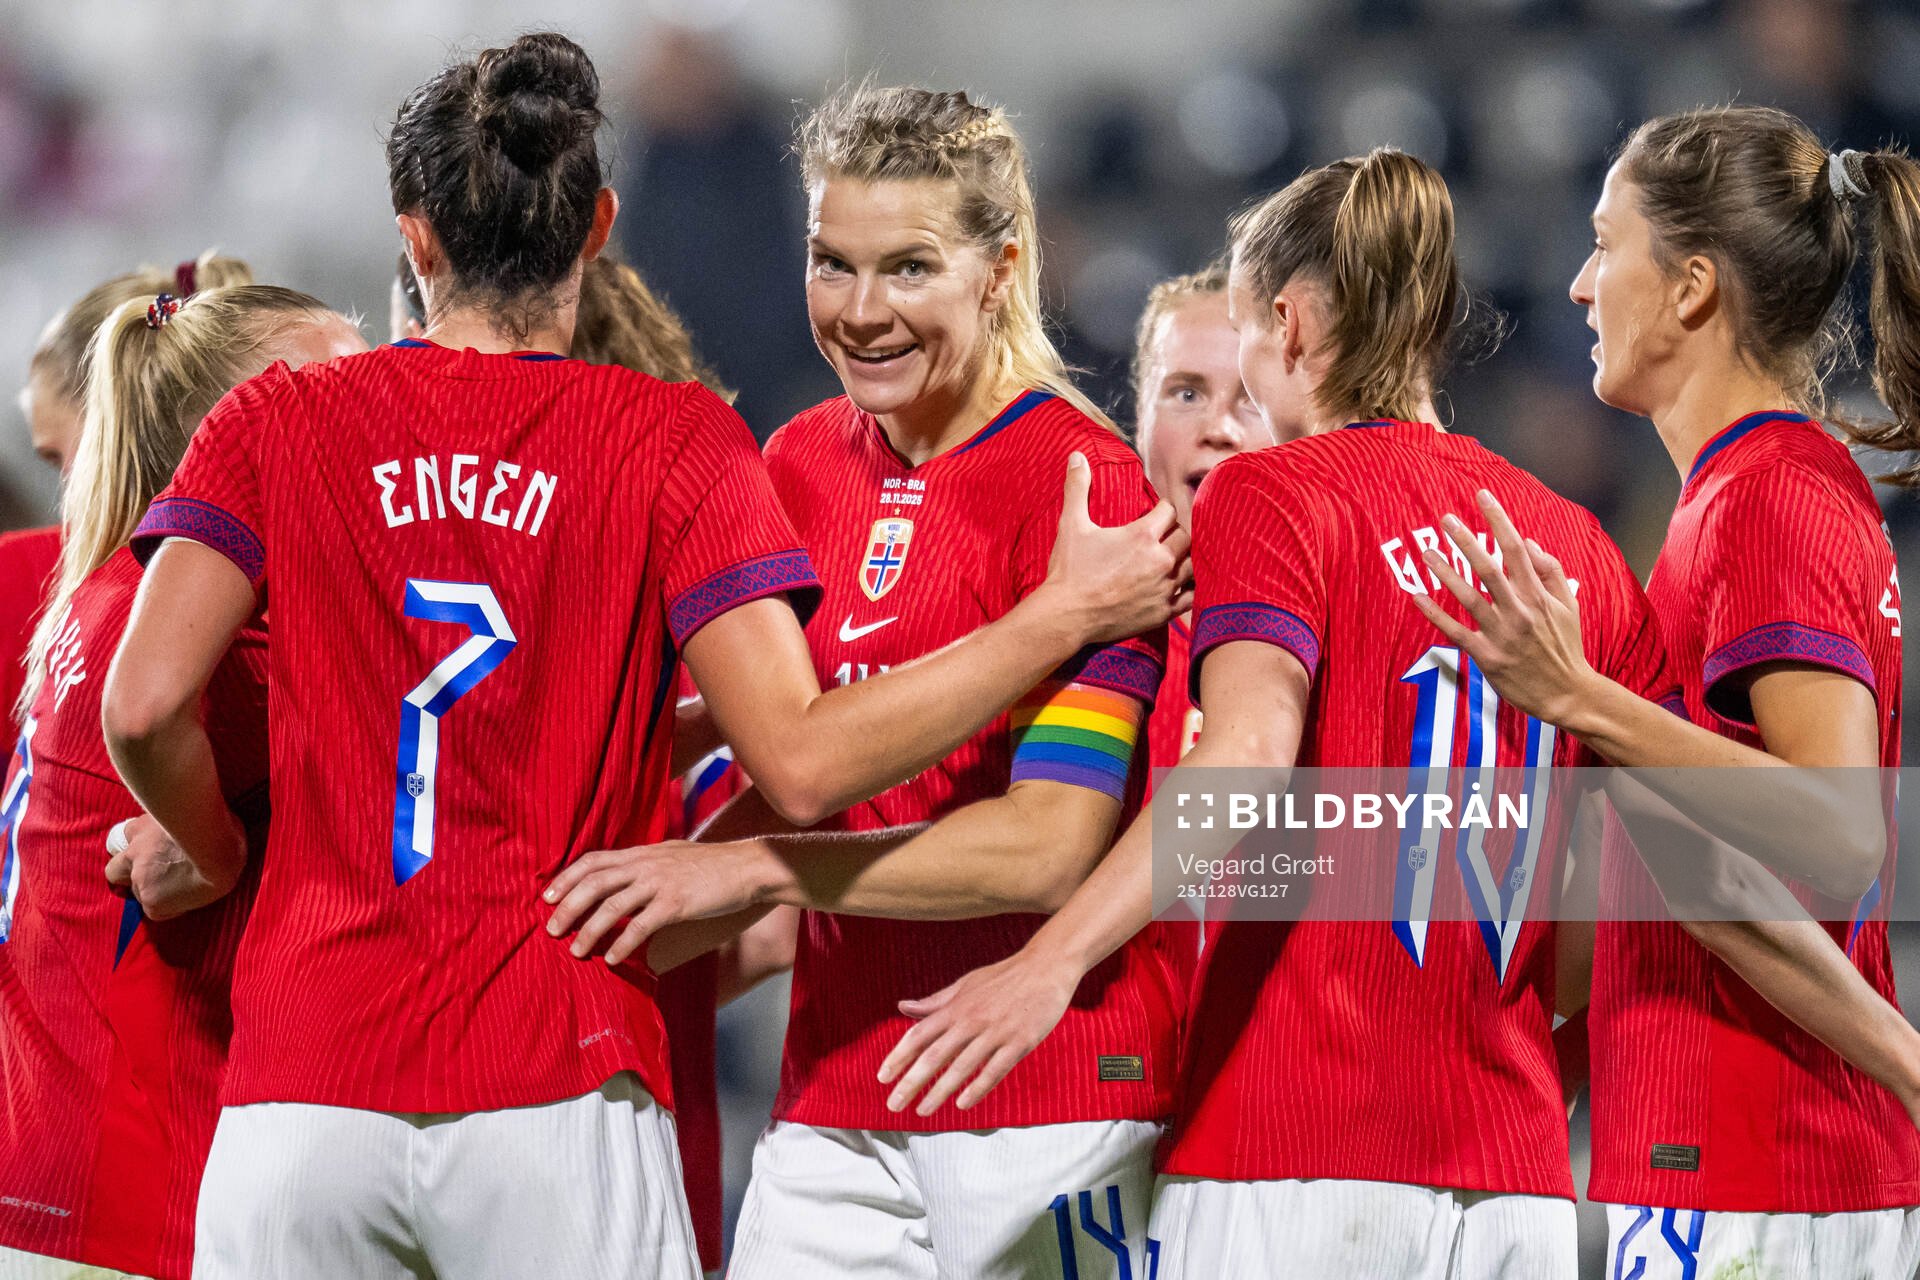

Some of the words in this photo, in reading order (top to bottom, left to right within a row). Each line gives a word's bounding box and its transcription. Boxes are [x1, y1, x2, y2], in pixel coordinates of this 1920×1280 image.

[372, 454, 558, 537] ENGEN
[391, 577, 518, 887] 7
[1047, 1185, 1132, 1280] 14
